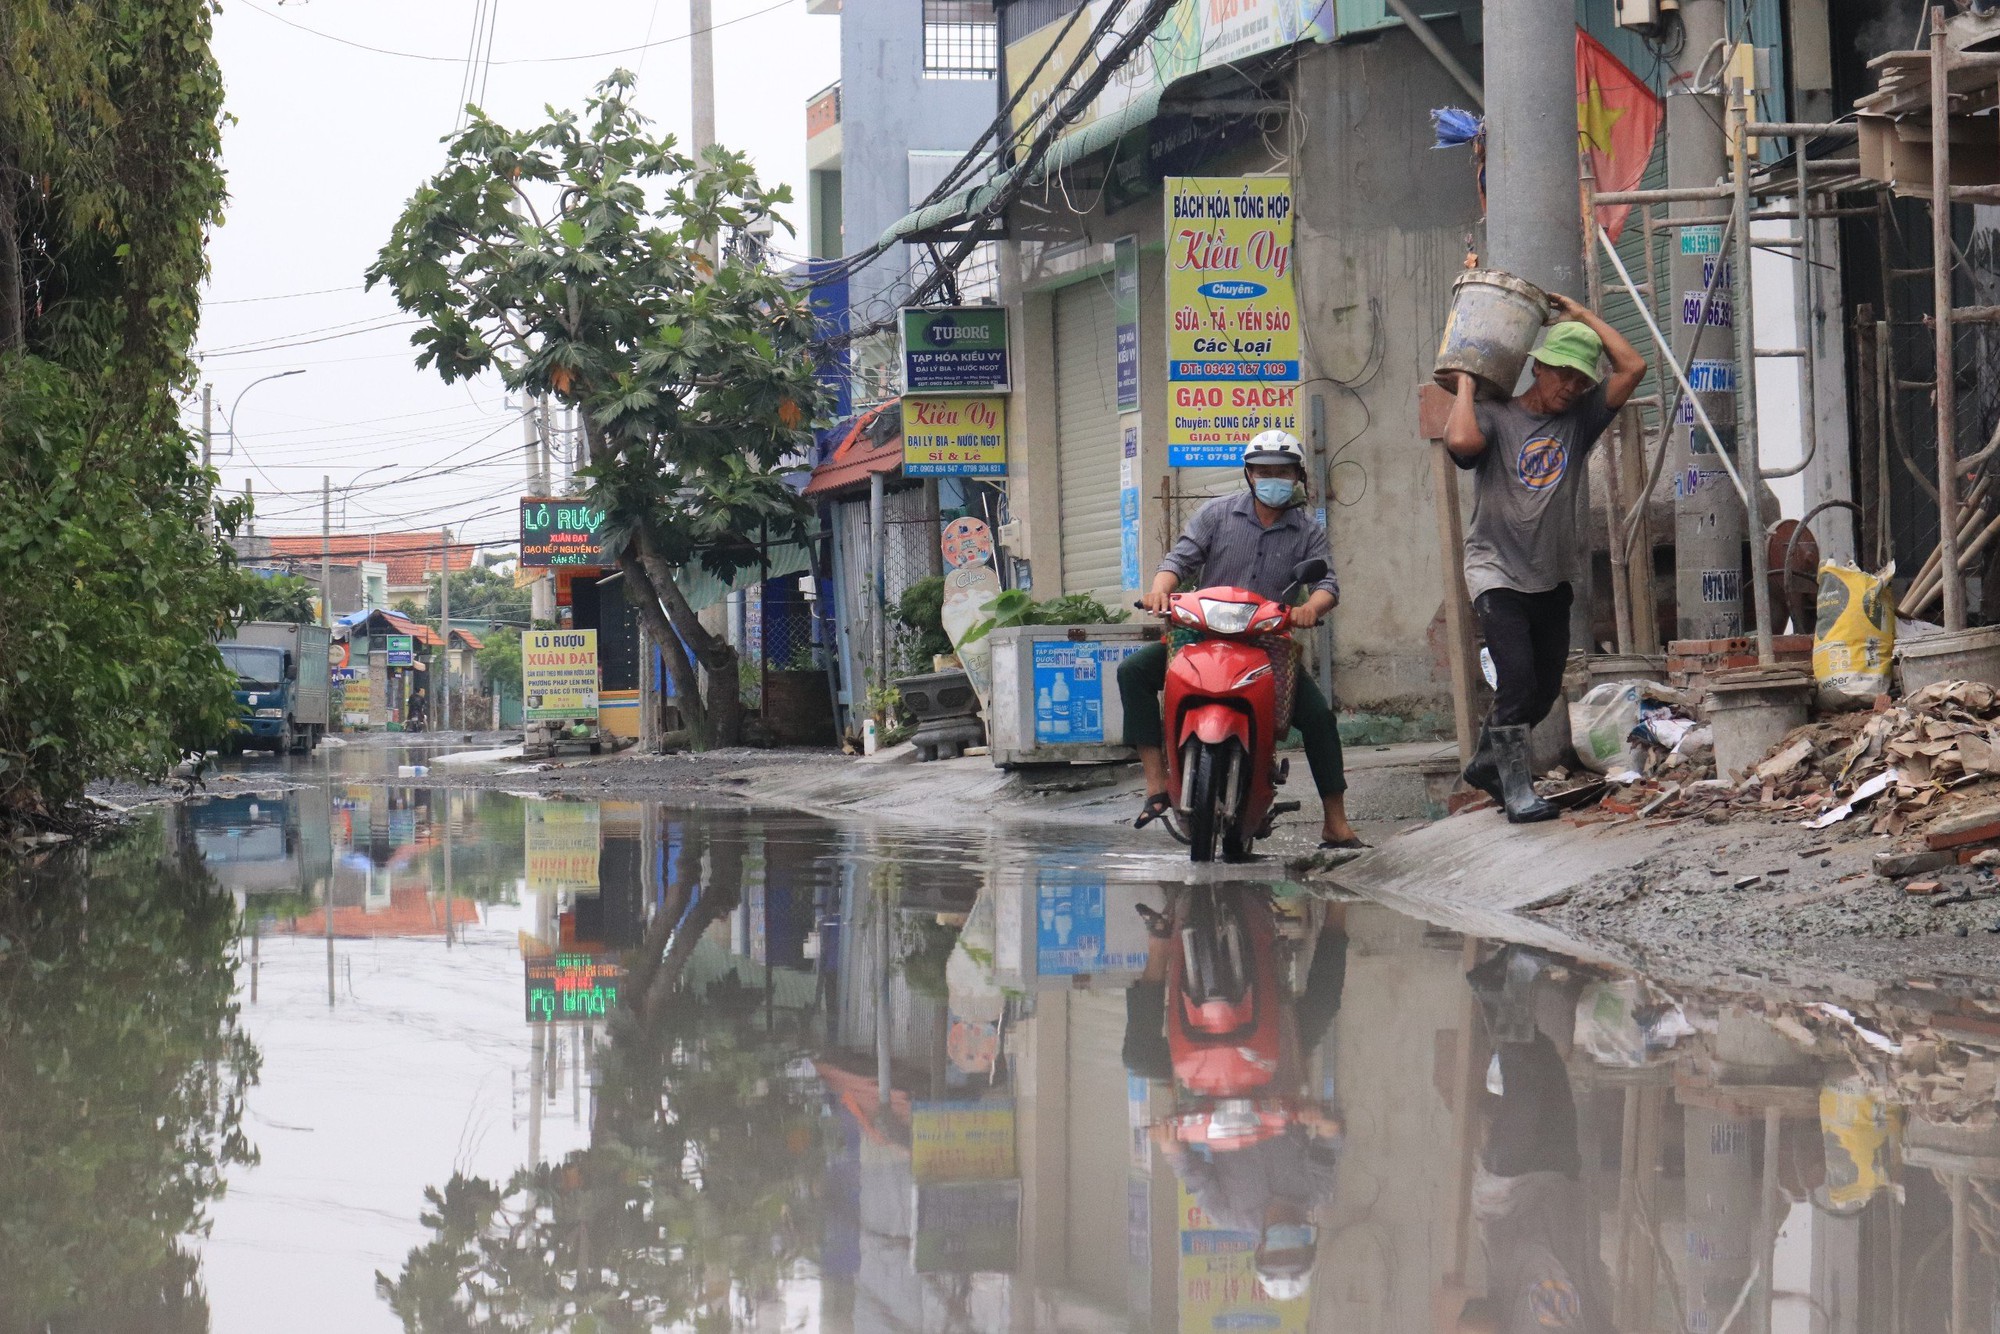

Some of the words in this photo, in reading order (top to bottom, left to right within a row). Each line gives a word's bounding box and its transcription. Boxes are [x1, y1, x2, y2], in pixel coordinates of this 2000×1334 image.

[1174, 189, 1204, 218] BÁCH
[1207, 190, 1230, 218] HÓA
[1234, 185, 1264, 219] TỔNG
[1268, 192, 1290, 226] HỢP
[1174, 228, 1241, 270] Kiều
[1212, 283, 1254, 296] Chuyên:
[1174, 305, 1200, 331] SỮA
[1210, 305, 1226, 331] TÃ
[1237, 303, 1262, 331] YẾN
[1265, 305, 1290, 331] SÀO
[933, 325, 989, 340] TUBORG
[1193, 338, 1228, 353] Các
[1233, 338, 1272, 357] Loại
[912, 354, 932, 365] TẠP
[935, 352, 958, 362] HÓA
[987, 353, 1001, 361] VY
[916, 366, 929, 374] ĐẠI
[1180, 363, 1201, 375] ĐT:
[1204, 363, 1235, 375] 0342
[1264, 363, 1286, 375] 109
[1176, 387, 1223, 411] GẠO
[1231, 387, 1294, 411] SẠCH
[909, 401, 960, 425] Kiều
[1175, 416, 1211, 431] Chuyên:
[1214, 416, 1239, 428] CUNG
[1242, 413, 1260, 428] CẤP
[1275, 417, 1281, 428] &
[908, 435, 921, 449] ĐẠI
[936, 435, 948, 446] BIA
[957, 433, 978, 446] NƯỚC
[981, 435, 1000, 449] NGỌT
[1190, 433, 1221, 442] GIAO
[948, 452, 958, 461] &
[1185, 453, 1204, 461] ĐT:
[1207, 453, 1237, 461] 0798
[525, 503, 550, 530] LÒ
[550, 532, 571, 543] XUÂN
[524, 545, 541, 554] GẠO
[542, 543, 558, 553] NẾP
[559, 544, 592, 553] NGUYÊN
[553, 635, 585, 650] RƯỢU
[528, 650, 565, 665] XUÂN
[569, 652, 595, 667] ĐẠT
[1821, 675, 1849, 690] weber
